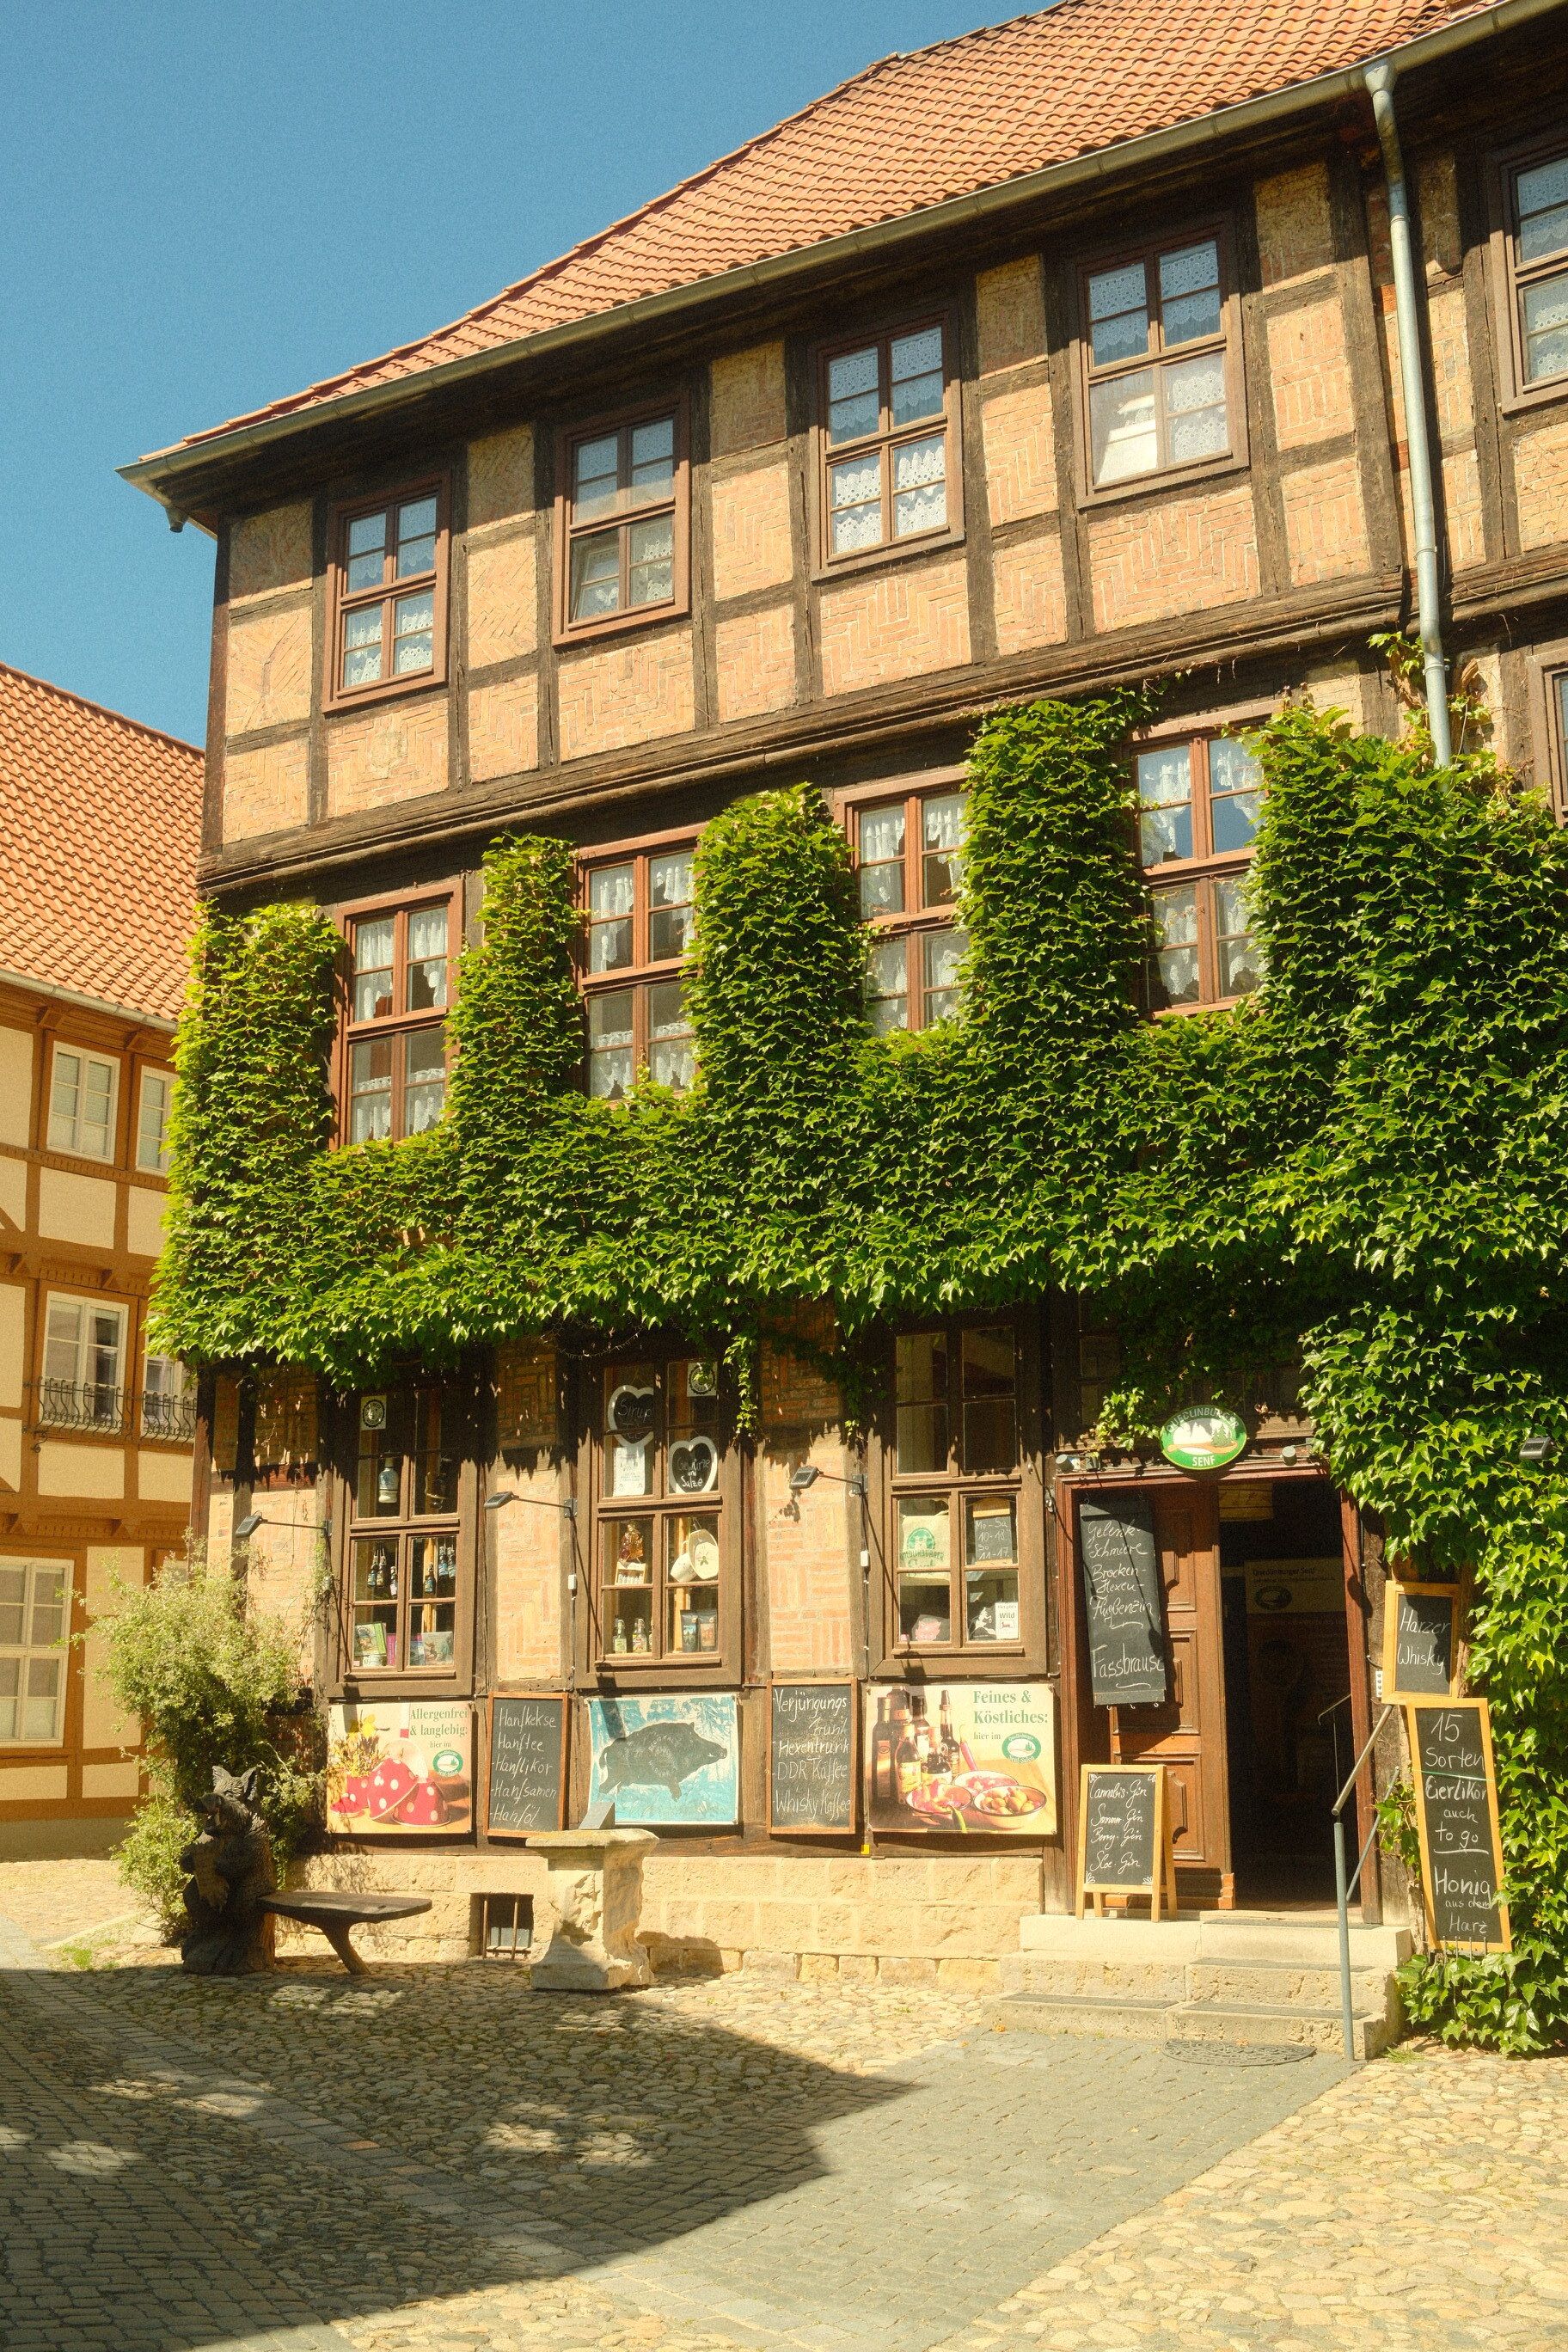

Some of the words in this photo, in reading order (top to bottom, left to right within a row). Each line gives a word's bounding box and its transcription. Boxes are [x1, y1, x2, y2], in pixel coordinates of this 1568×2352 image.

[617, 1399, 653, 1422] Sirup
[1191, 1455, 1216, 1467] SENF
[1089, 1539, 1148, 1559] Schmiere
[1400, 1608, 1450, 1634] Harzer
[1092, 1643, 1165, 1678] Fassbrause
[1397, 1643, 1445, 1675] Whisky
[775, 1688, 847, 1723] Verjüngungs
[973, 1690, 1016, 1703] Feines
[1021, 1690, 1032, 1703] &
[411, 1707, 469, 1721] Allergenfrei
[499, 1706, 556, 1734] Hanfkekse
[973, 1709, 1048, 1724] Köstliches:
[409, 1725, 417, 1736] &
[421, 1724, 468, 1738] langlebig:
[973, 1731, 989, 1740] hier
[1430, 1712, 1463, 1743] 15
[498, 1732, 544, 1755] Hanftee
[778, 1738, 849, 1758] Hexentrunk
[777, 1760, 809, 1781] DDR
[810, 1758, 848, 1785] Kaffee
[1425, 1747, 1485, 1772] Sorten
[494, 1779, 556, 1804] Hanfsamen
[1425, 1775, 1486, 1801] Eierlikör
[493, 1803, 541, 1828] Hanföl
[775, 1786, 818, 1821] Whisky
[820, 1788, 851, 1821] Kaffee
[1443, 1807, 1478, 1823] auch
[1435, 1821, 1454, 1841] to
[1460, 1829, 1479, 1848] go
[1434, 1865, 1492, 1907] Honig
[1445, 1899, 1464, 1908] aus
[1467, 1896, 1490, 1908] dem
[1449, 1912, 1487, 1934] Harz
